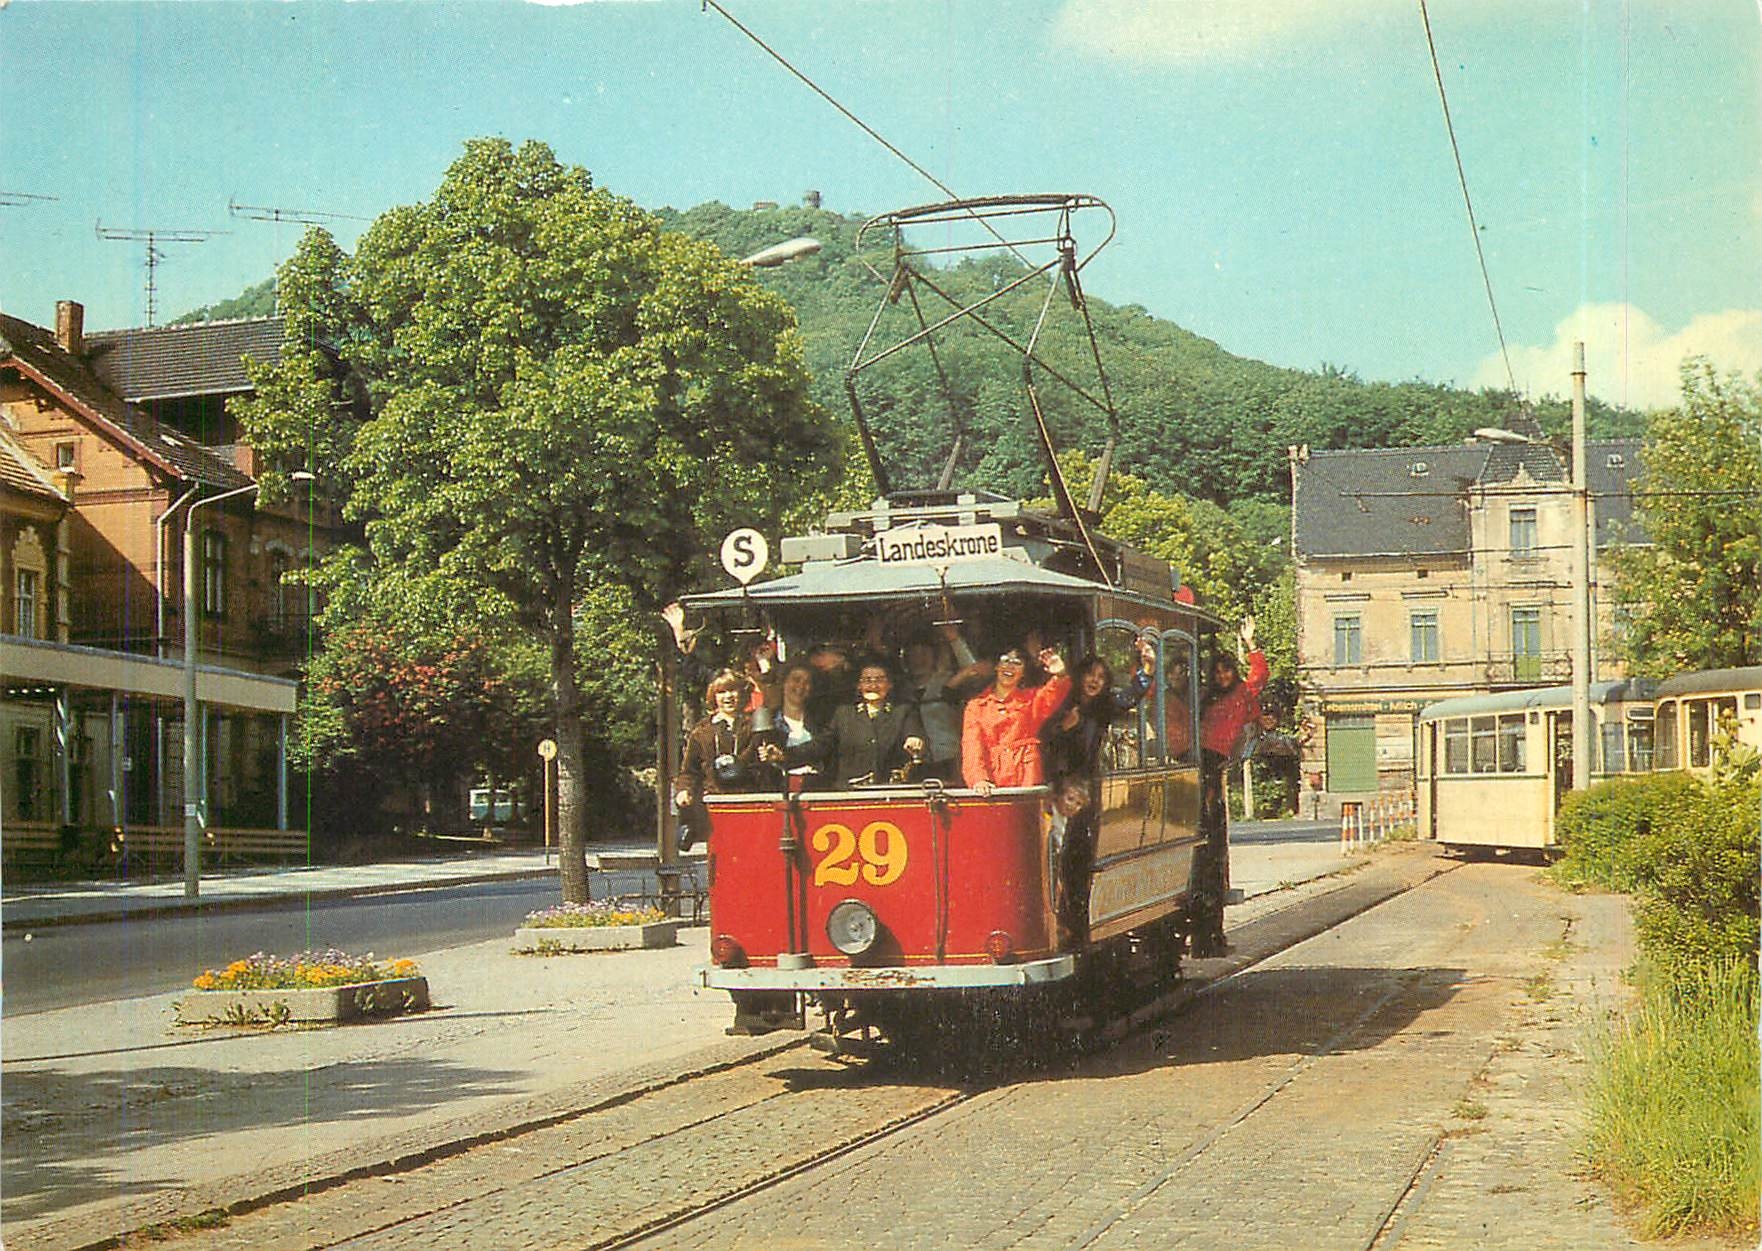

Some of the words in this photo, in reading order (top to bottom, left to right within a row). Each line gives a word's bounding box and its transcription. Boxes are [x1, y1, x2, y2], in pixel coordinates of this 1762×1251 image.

[734, 535, 755, 567] S
[878, 532, 999, 563] Landeskrone
[812, 821, 908, 887] 29
